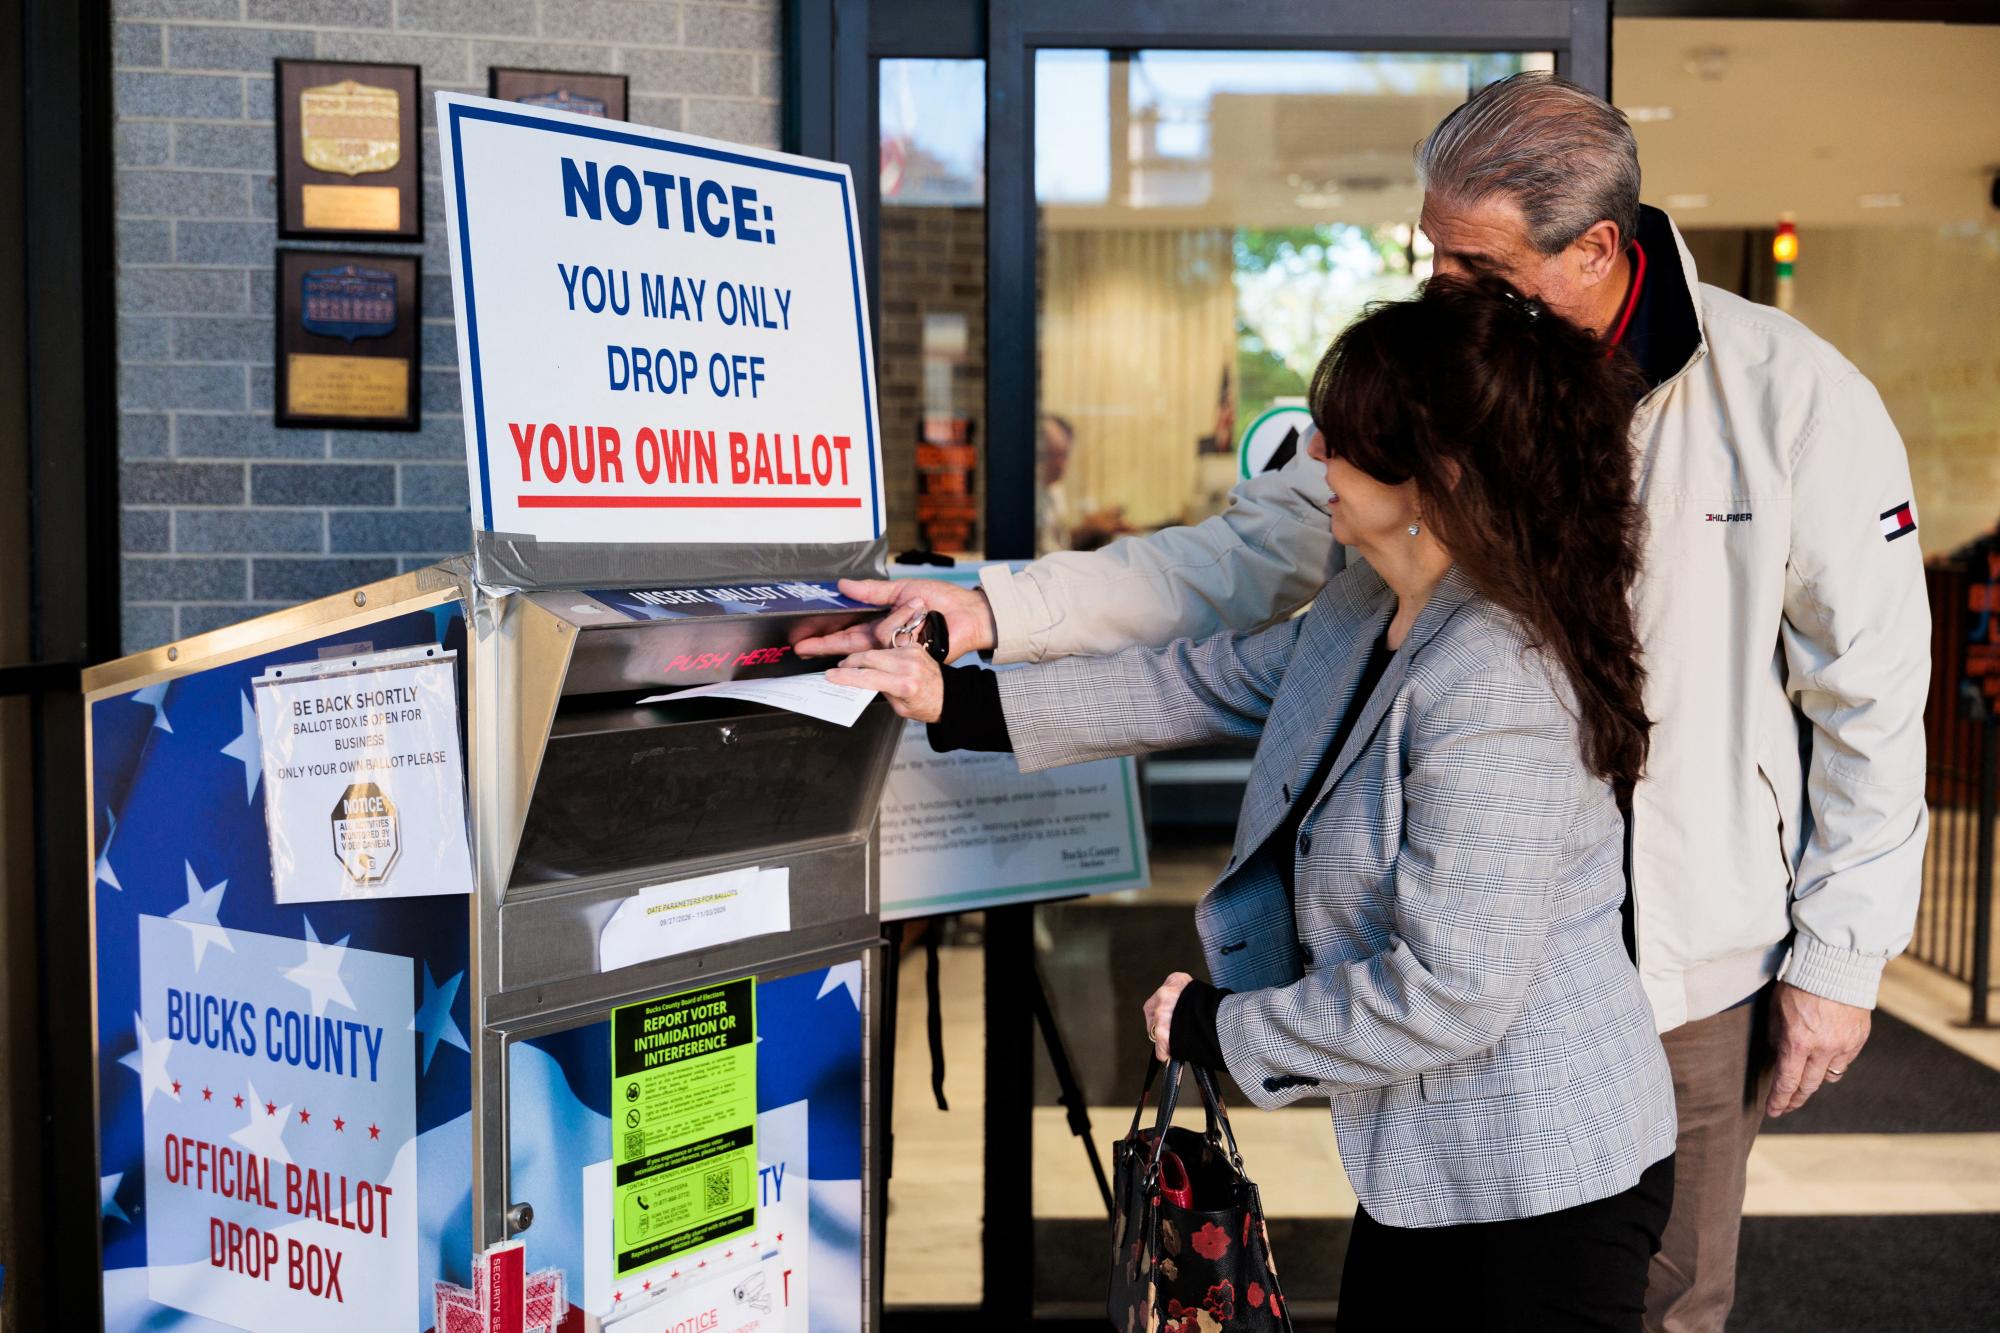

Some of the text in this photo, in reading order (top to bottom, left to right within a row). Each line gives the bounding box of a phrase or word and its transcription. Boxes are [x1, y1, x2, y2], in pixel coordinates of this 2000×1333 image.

[560, 157, 775, 245] NOTICE:
[558, 263, 791, 330] YOU MAY ONLY
[607, 345, 765, 398] DROP OFF
[508, 423, 624, 484] YOUR
[635, 427, 718, 485] OWN
[729, 432, 852, 486] BALLOT
[1712, 513, 1752, 522] HILFIGER
[629, 590, 708, 605] INSERT
[707, 586, 781, 602] BALLOT
[664, 646, 790, 673] PUSH HERE
[294, 686, 418, 716] BE BACK SHORTLY
[293, 709, 422, 735] BALLOT BOX IS OPEN FOR
[335, 734, 384, 750] BUSINESS
[278, 751, 446, 779] ONLY YOUR OWN BALLOT PLEASE
[343, 796, 384, 815] NOTICE
[647, 904, 662, 915] DATE
[662, 897, 700, 912] PARAMETERS
[644, 1000, 727, 1033] REPORT VOTER
[646, 1006, 661, 1015] Bucks
[662, 1001, 680, 1011] County
[167, 988, 384, 1082] BUCKS COUNTY
[634, 1015, 736, 1053] INTIMIDATION OR
[644, 1033, 727, 1067] INTERFERENCE
[164, 1133, 393, 1239] OFFICIAL BALLOT
[210, 1217, 344, 1304] DROP BOX
[493, 1258, 501, 1312] SECURITY
